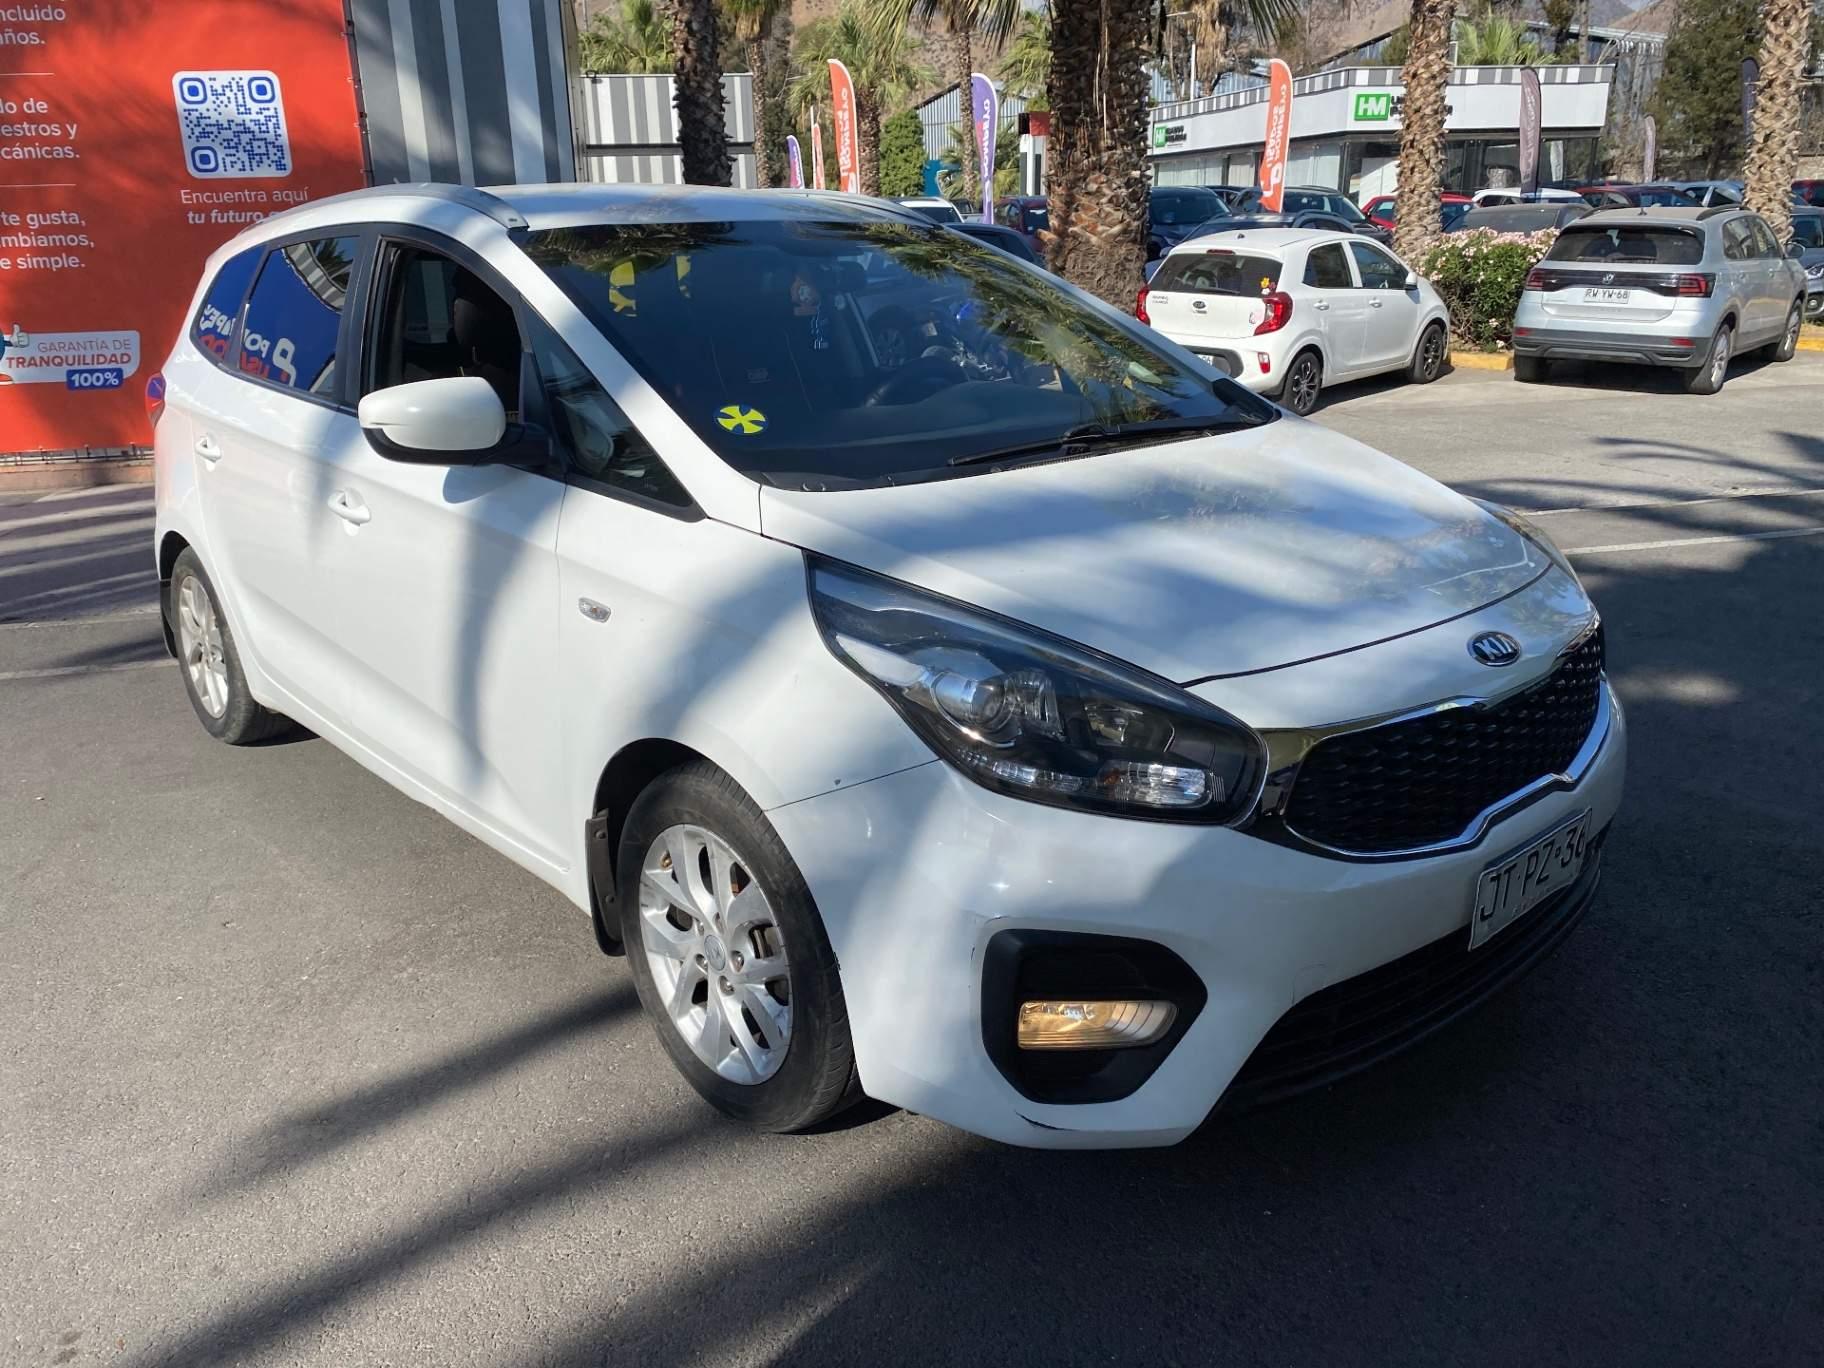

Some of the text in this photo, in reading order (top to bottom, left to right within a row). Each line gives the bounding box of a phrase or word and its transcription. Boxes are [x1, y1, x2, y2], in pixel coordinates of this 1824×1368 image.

[23, 97, 48, 114] de
[1357, 96, 1387, 116] HM
[0, 122, 78, 140] estros y
[0, 142, 80, 159] cánicas.
[180, 186, 310, 204] Encuentra aquí
[0, 210, 86, 229] te gusta,
[187, 210, 205, 224] tu
[210, 209, 264, 223] futuro
[16, 252, 86, 271] simple.
[37, 337, 132, 353] GARANTÍA DE
[6, 352, 132, 368] TRANQUILIDAD
[71, 371, 120, 387] 100%
[1474, 634, 1517, 660] KIA
